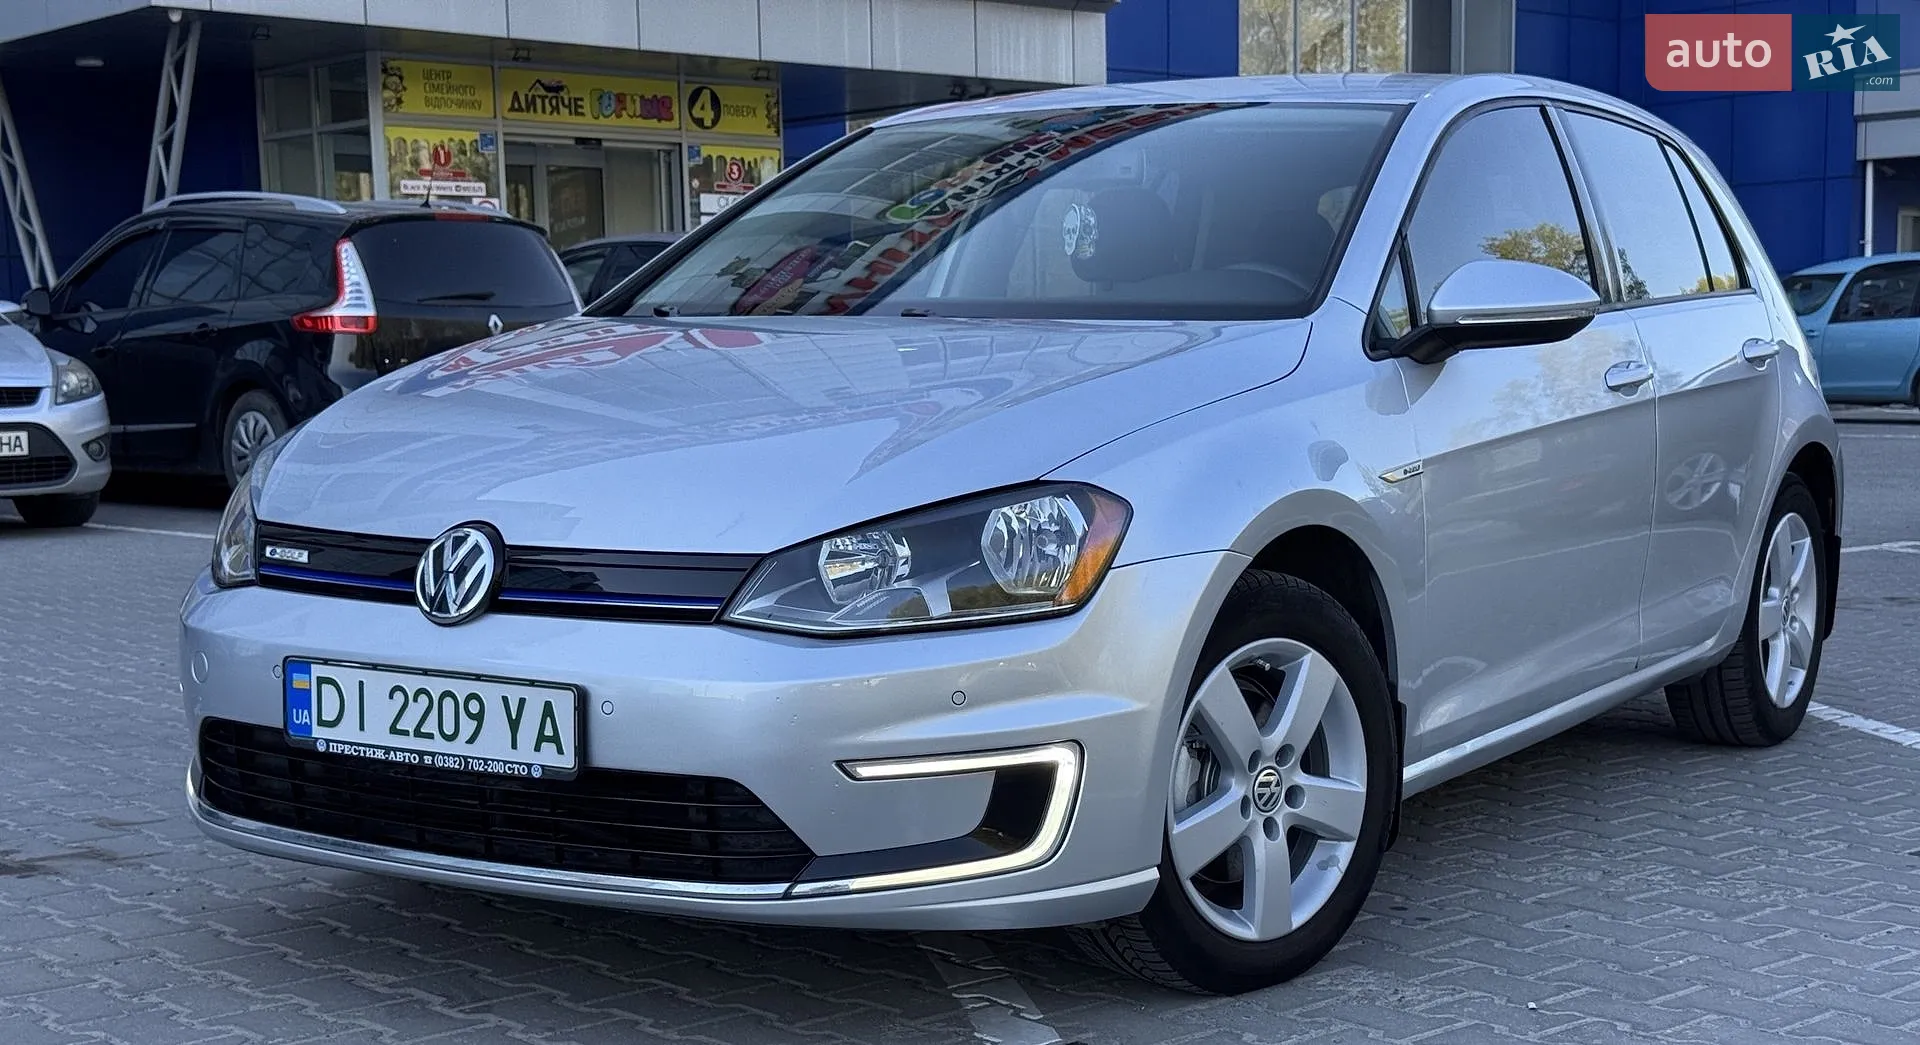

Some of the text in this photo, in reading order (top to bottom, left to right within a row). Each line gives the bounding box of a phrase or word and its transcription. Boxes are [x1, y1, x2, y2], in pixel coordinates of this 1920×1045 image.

[422, 67, 452, 81] ЦЕНТР
[423, 81, 476, 97] СІМЕЙНОГО
[423, 95, 482, 111] ВІДПОЧИНКУ
[507, 90, 586, 117] ДИТЯЧЕ
[691, 87, 758, 128] 4 ПОВЕРХ
[292, 708, 311, 726] UA
[316, 676, 565, 756] DI 2209 YA
[328, 742, 420, 764] ПРЕСТИЖ-АВТО
[434, 755, 465, 771] (0382)
